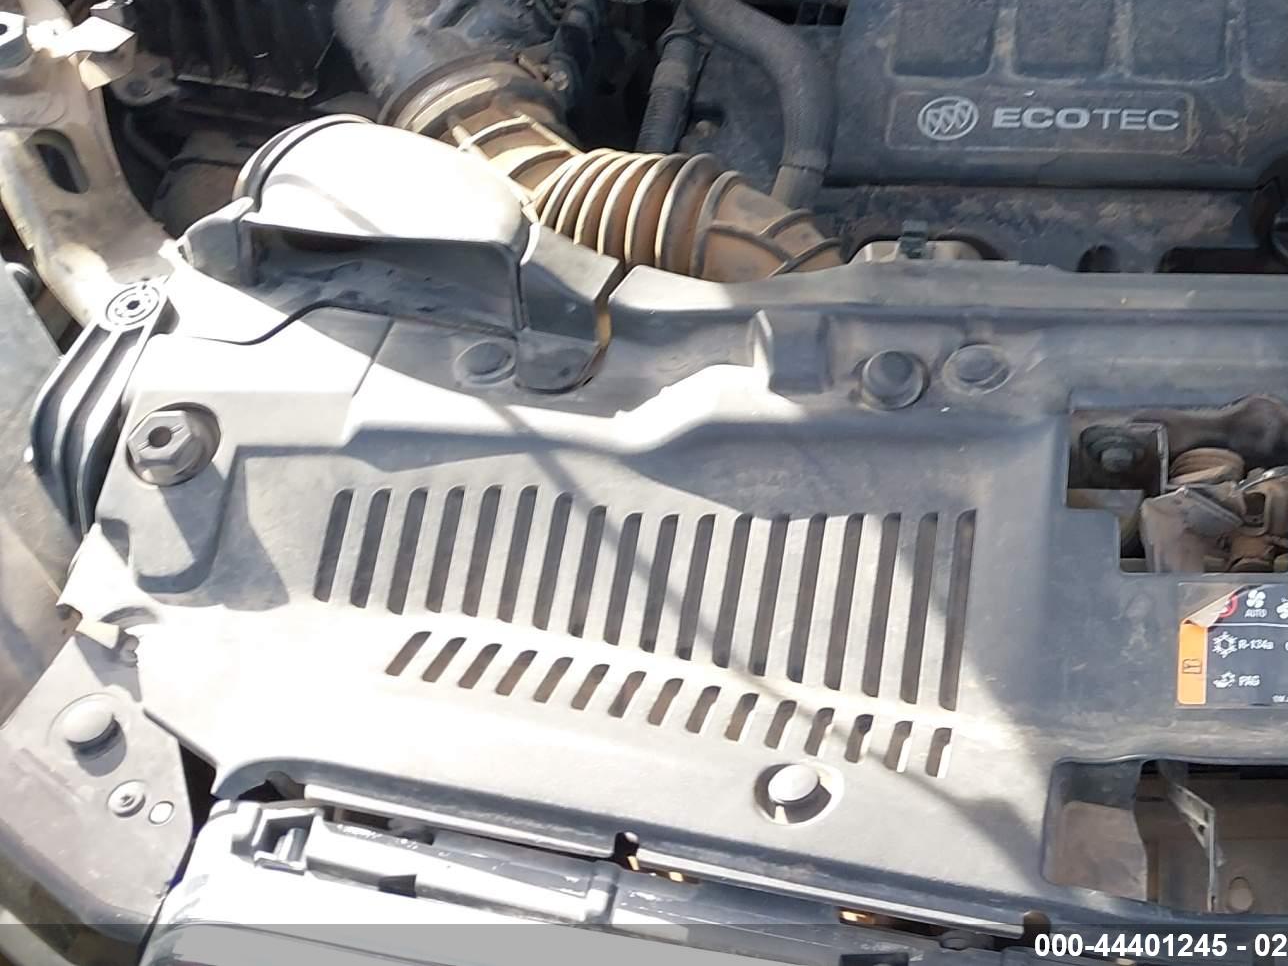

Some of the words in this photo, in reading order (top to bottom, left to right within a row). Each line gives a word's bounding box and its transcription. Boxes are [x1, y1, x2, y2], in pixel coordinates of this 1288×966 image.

[992, 107, 1180, 131] ECOTEC
[1244, 608, 1268, 618] AUTO
[1237, 639, 1274, 650] R-134a
[1238, 675, 1261, 687] PAG
